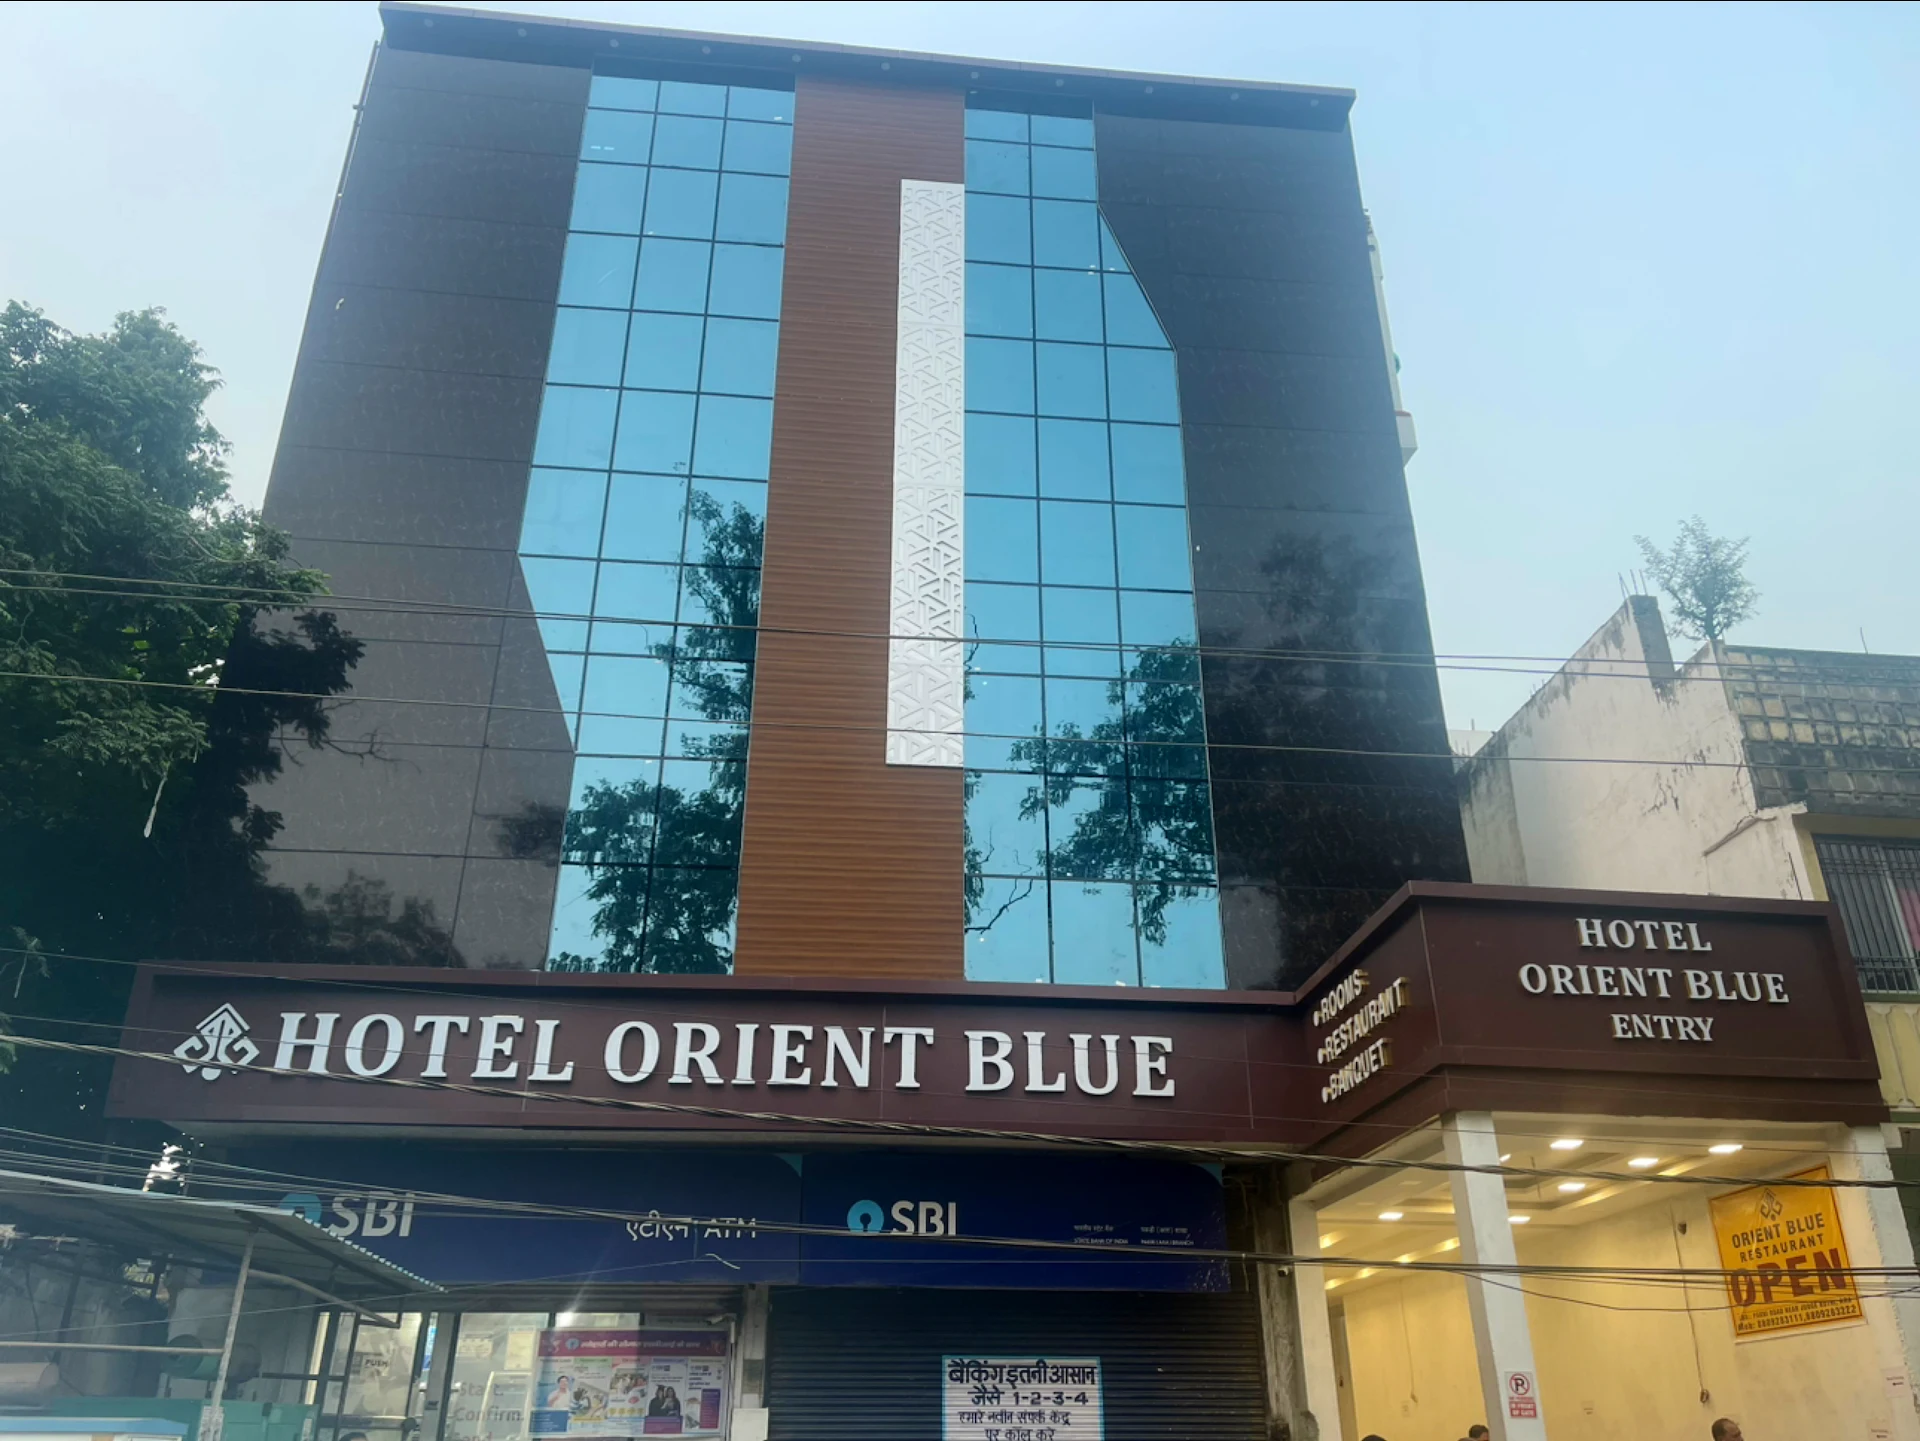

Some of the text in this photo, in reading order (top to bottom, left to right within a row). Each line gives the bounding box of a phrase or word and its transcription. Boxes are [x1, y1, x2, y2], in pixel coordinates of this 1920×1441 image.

[1576, 918, 1712, 951] HOTEL
[1320, 968, 1366, 1023] ROOMS
[1519, 963, 1789, 1003] ORIENT BLUE
[1325, 977, 1406, 1062] RESTAURANT
[1610, 1013, 1714, 1042] ENTRY
[273, 1012, 1176, 1097] HOTEL ORIENT BLUE
[1329, 1037, 1387, 1100] BANQUET
[327, 1190, 416, 1237] SBI
[704, 1217, 757, 1239] ATM
[891, 1200, 956, 1236] SBI
[1732, 1212, 1825, 1249] ORIENT BLUE
[1740, 1233, 1824, 1263] RESTAURANT
[1730, 1248, 1847, 1306] OPEN
[1005, 1359, 1049, 1389] इतनी
[1049, 1365, 1098, 1385] आसान
[967, 1383, 1089, 1406] जैसे 1-2-3-4
[958, 1409, 986, 1424] हमारे
